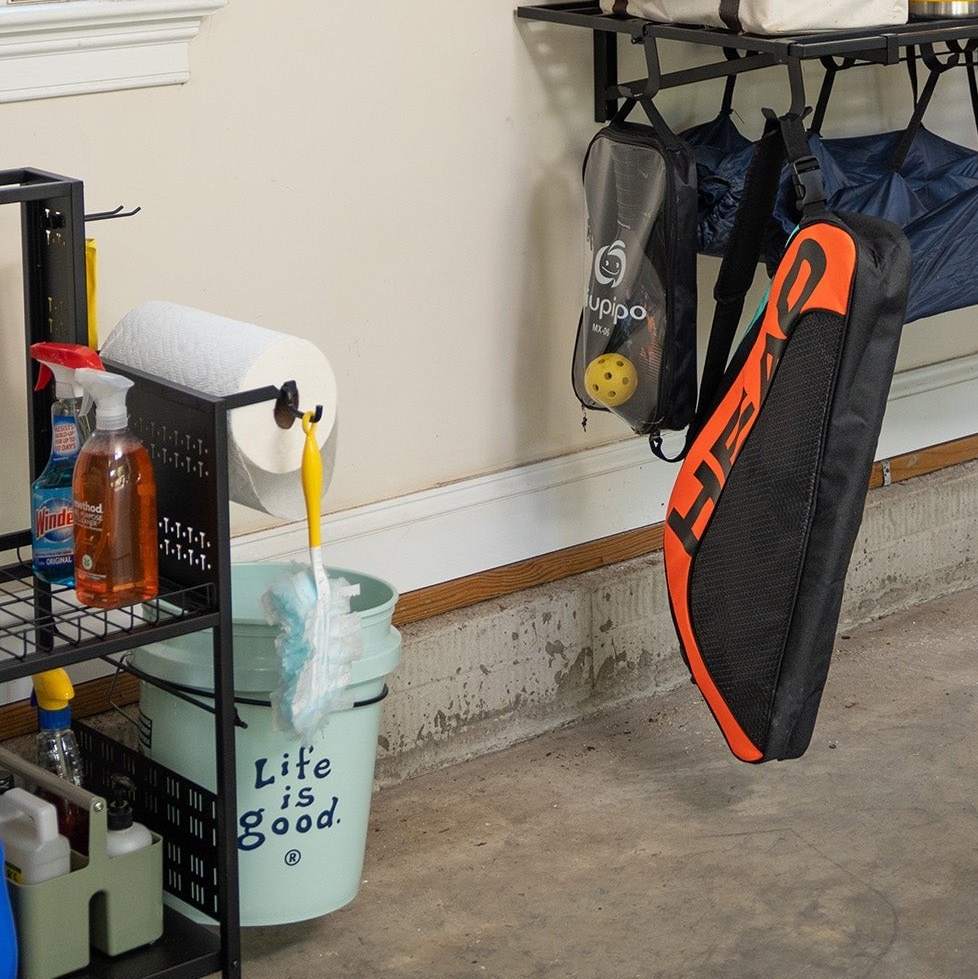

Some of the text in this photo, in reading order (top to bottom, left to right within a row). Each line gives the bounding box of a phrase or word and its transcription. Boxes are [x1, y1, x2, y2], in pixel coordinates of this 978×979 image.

[668, 237, 828, 558] HEAD
[62, 442, 77, 451] DAYS
[35, 505, 74, 540] Winde
[46, 556, 73, 566] ORIGINAL
[254, 745, 332, 790] Life
[280, 785, 314, 810] is
[237, 796, 341, 851] good.
